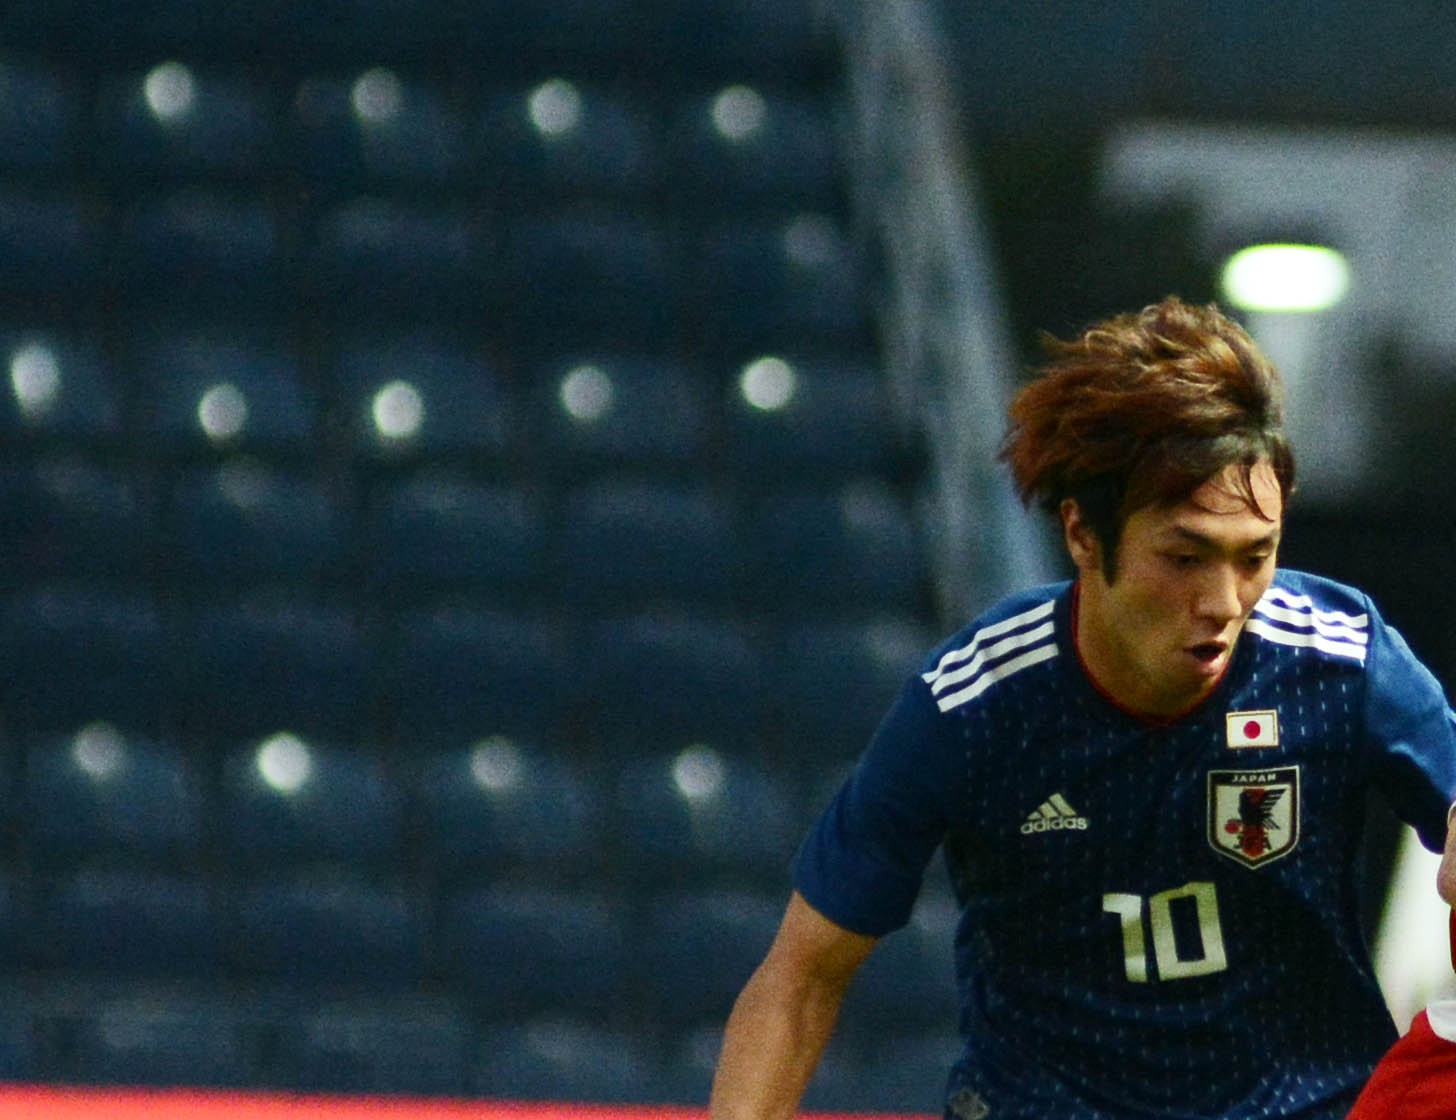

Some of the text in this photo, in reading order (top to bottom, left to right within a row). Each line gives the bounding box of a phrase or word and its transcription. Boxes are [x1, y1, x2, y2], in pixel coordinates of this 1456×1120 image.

[1232, 773, 1277, 783] JAPAN
[1020, 816, 1088, 834] adidas
[1102, 881, 1228, 982] 10
